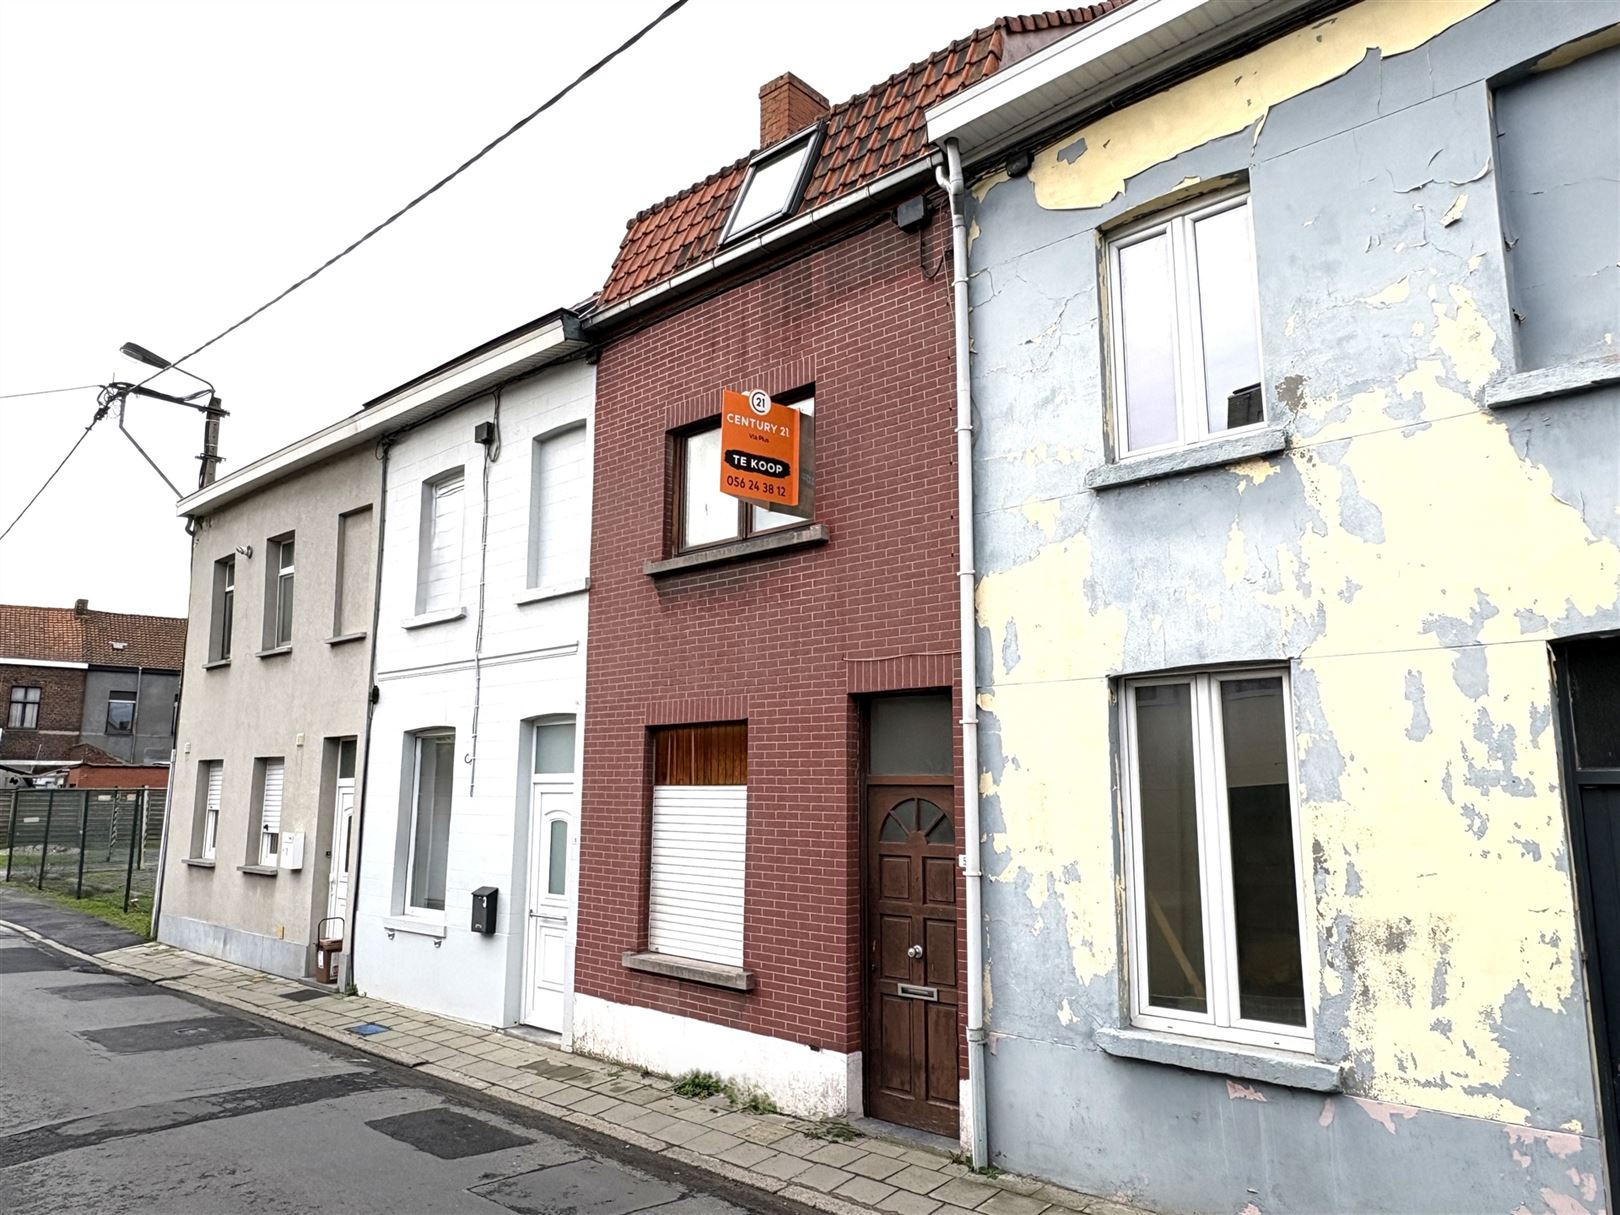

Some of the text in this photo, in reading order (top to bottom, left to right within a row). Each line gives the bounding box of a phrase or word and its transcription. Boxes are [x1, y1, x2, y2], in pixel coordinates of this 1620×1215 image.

[727, 413, 790, 438] CENTURY 21
[733, 454, 783, 474] TE KOOP
[727, 475, 786, 497] 056 24 38 12
